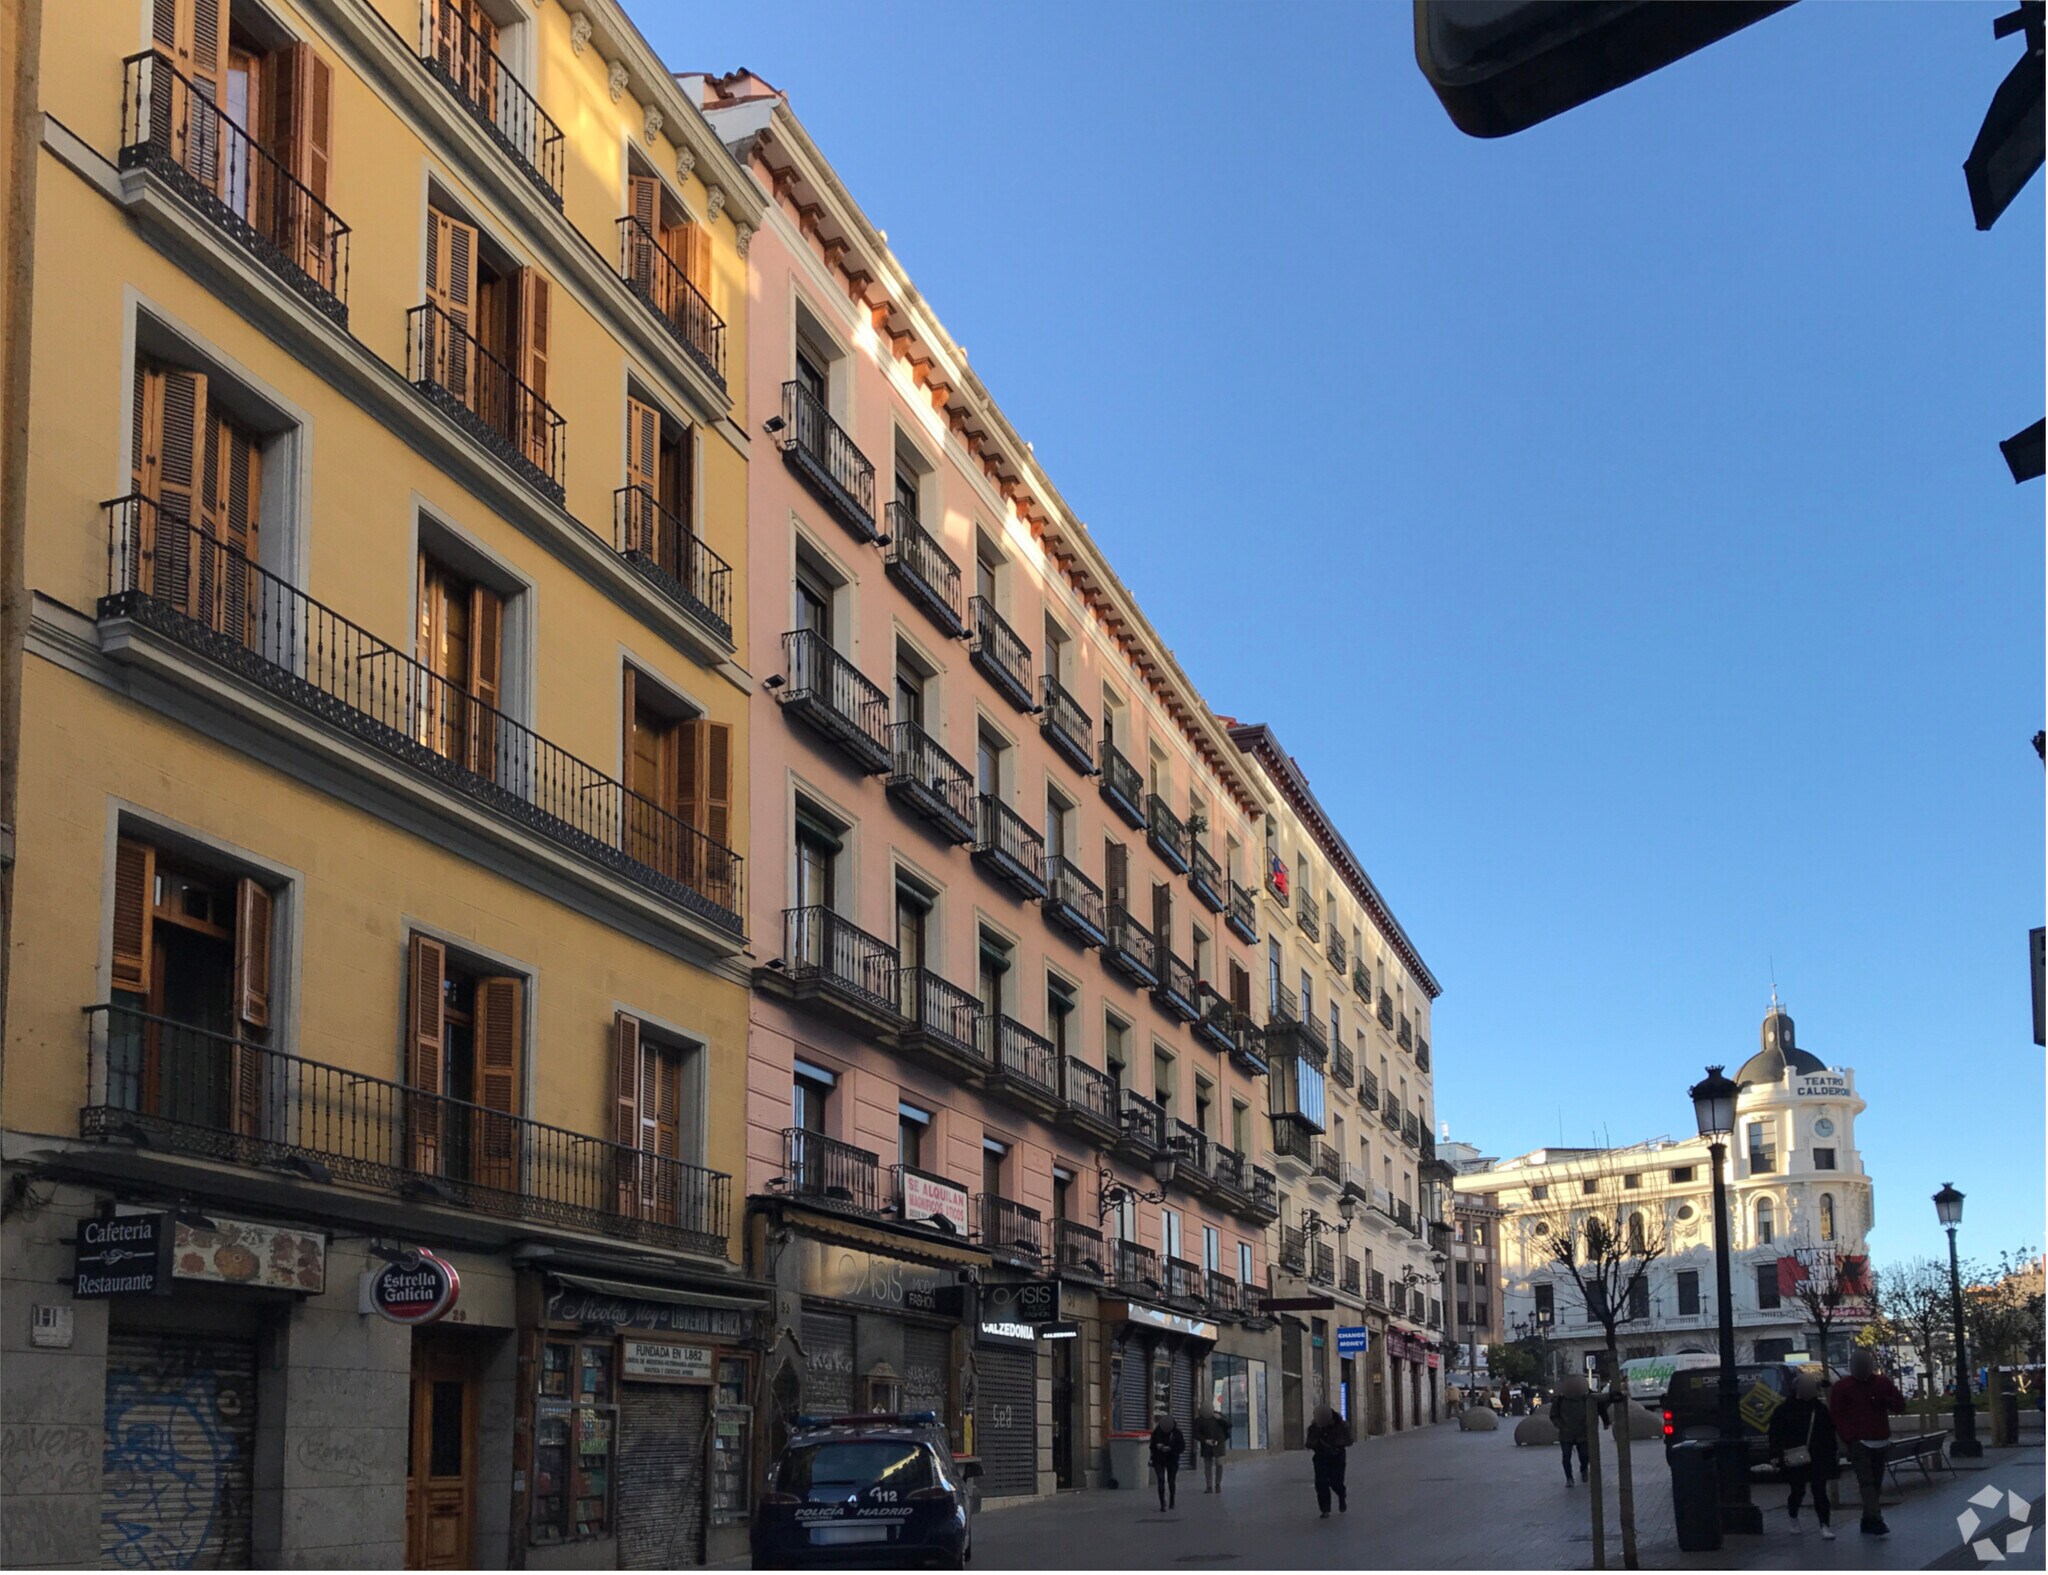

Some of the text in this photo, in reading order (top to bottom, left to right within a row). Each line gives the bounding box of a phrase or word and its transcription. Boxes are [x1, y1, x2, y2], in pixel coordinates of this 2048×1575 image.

[1804, 1077, 1844, 1086] TEATRO
[908, 1177, 964, 1206] SE ALQUILAN
[85, 1219, 152, 1244] Cafetería
[78, 1273, 153, 1294] Restaurante
[383, 1272, 436, 1288] Estrella
[838, 1253, 903, 1303] OASIS
[384, 1286, 434, 1302] Galicia
[993, 1286, 1051, 1304] OASIS
[562, 1301, 628, 1324] Nicolás
[627, 1304, 668, 1330] Moya
[982, 1322, 1034, 1340] CALZEDONIA
[1043, 1331, 1077, 1339] CALZEDONIA
[636, 1344, 670, 1359] FUNDADA
[672, 1348, 681, 1359] EN
[877, 1491, 898, 1503] 112
[857, 1507, 913, 1516] MADRID
